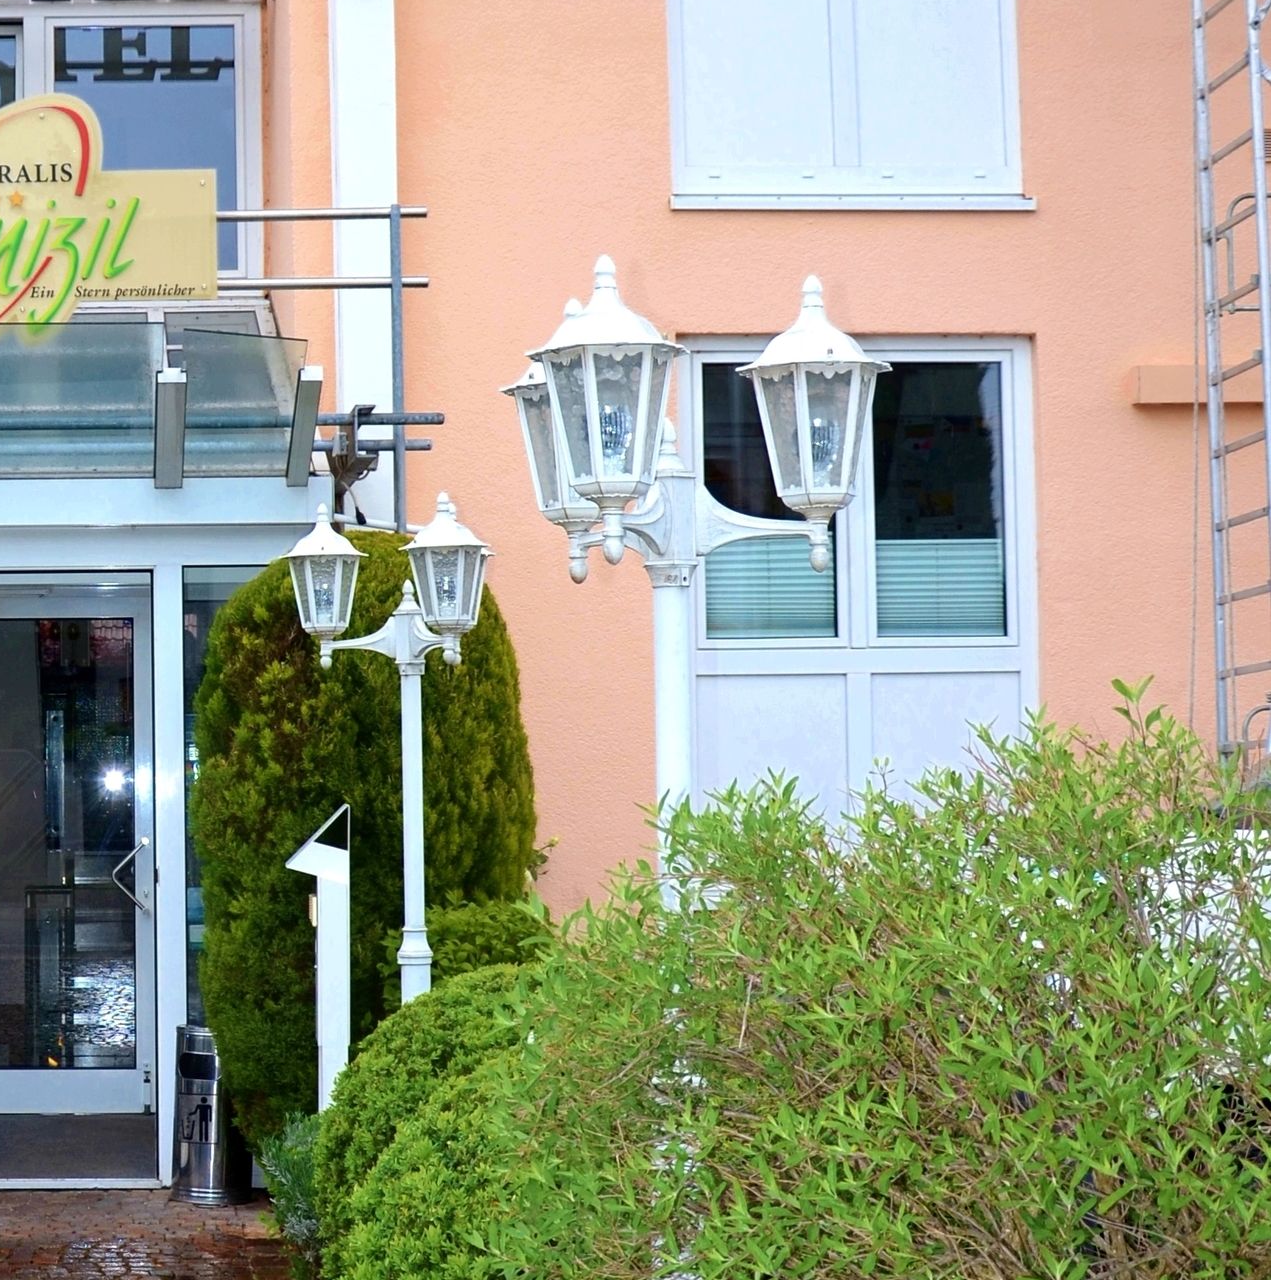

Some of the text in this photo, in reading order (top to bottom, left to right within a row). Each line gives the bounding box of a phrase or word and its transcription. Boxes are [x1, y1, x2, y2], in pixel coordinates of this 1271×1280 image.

[30, 283, 196, 300] Ein Stern persönlicher
